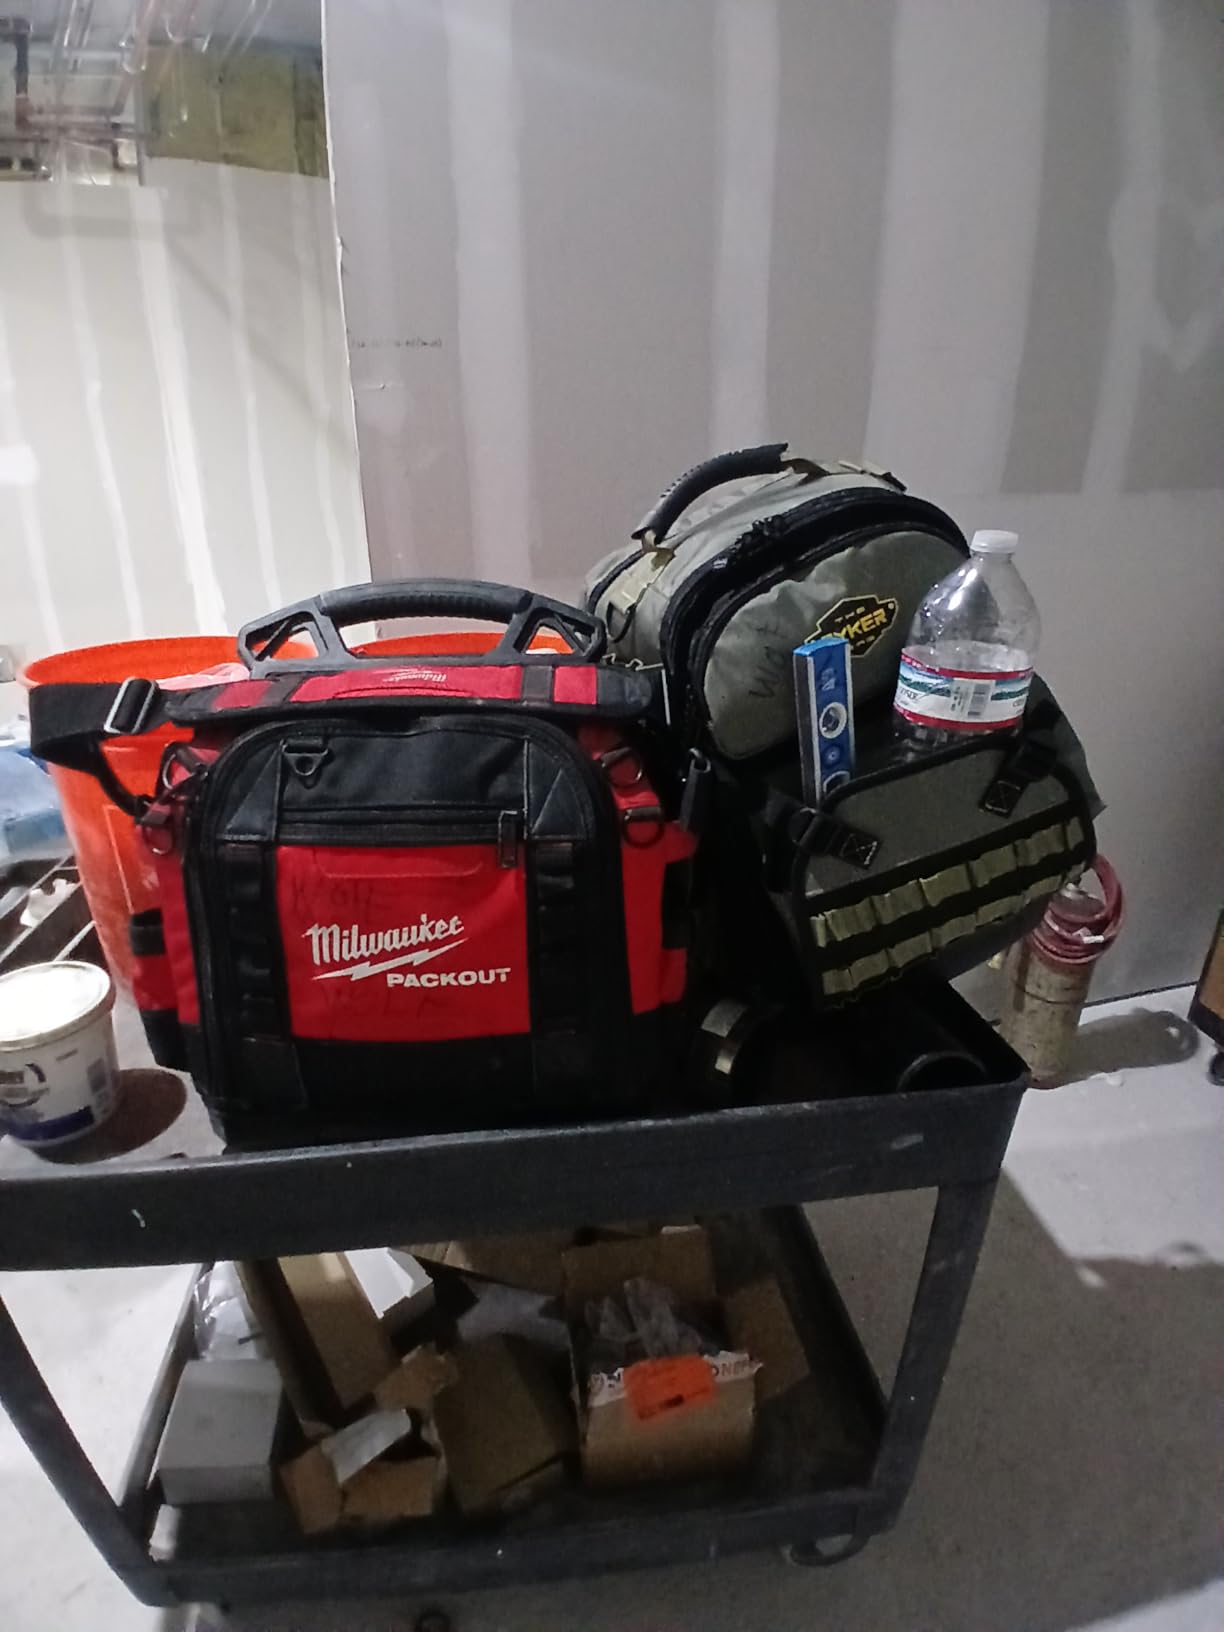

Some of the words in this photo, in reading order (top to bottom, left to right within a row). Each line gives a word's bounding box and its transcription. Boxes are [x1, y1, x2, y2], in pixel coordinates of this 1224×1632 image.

[821, 608, 888, 640] YKER
[302, 914, 465, 965] Milwaukee
[386, 968, 511, 987] PACKOUT
